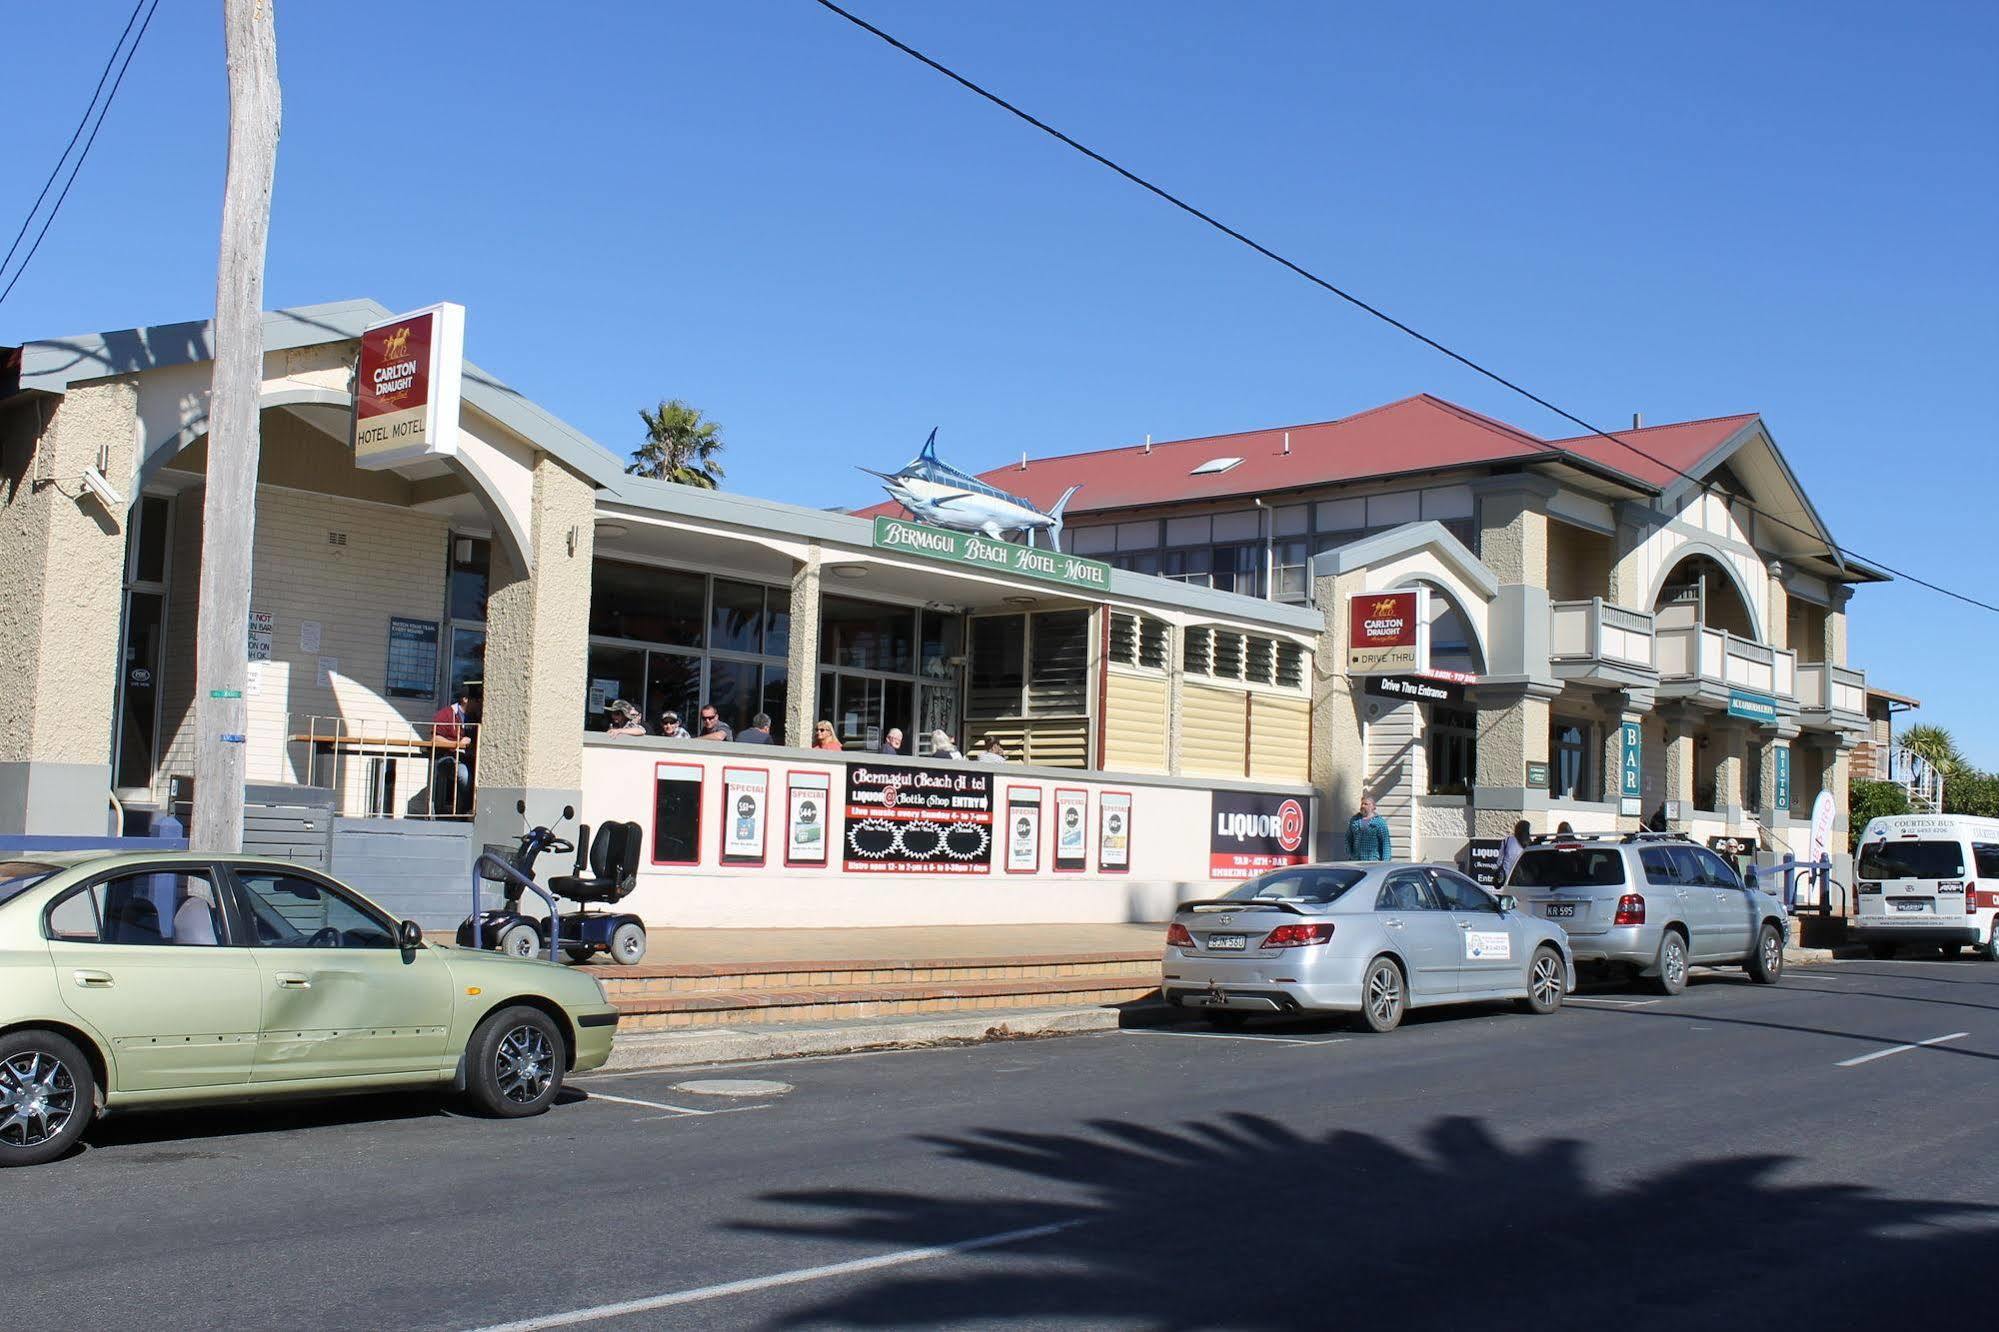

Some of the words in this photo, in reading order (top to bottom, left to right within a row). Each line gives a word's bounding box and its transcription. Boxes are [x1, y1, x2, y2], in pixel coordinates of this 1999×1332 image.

[374, 360, 417, 383] CARLTON
[376, 376, 413, 396] DRAUGHT
[358, 427, 388, 445] HOTEL
[392, 419, 425, 438] MOTEL
[883, 522, 954, 553] BERMAGUI
[963, 538, 1007, 564] BEACH
[256, 613, 273, 622] NOT
[259, 623, 272, 632] BAR
[1364, 618, 1404, 629] CARLTON
[1366, 628, 1401, 637] DRAUGHT
[260, 643, 270, 651] ON
[1361, 654, 1387, 664] DRIVE
[1392, 653, 1415, 662] THRU
[1381, 678, 1400, 692] Drive
[1402, 681, 1417, 695] Thru
[1418, 684, 1448, 699] Entrance
[1626, 728, 1637, 788] BAR
[852, 768, 912, 789] Bermagui
[914, 772, 952, 788] Beach
[954, 775, 986, 791] Htel
[1779, 750, 1787, 806] BISTRO
[729, 784, 765, 793] SPECIAL
[792, 791, 824, 799] SPECIAL
[896, 793, 925, 805] Bottle
[926, 795, 950, 807] Shop
[951, 796, 980, 809] ENTRY
[851, 807, 868, 815] Live
[870, 808, 895, 817] music
[897, 810, 919, 819] every
[921, 810, 950, 820] Sunday
[1894, 819, 1935, 828] COURTESY
[1938, 819, 1955, 827] BUS
[1472, 848, 1500, 859] LIQUO
[1212, 867, 1247, 878] SMOKING
[1477, 873, 1495, 883] Entr
